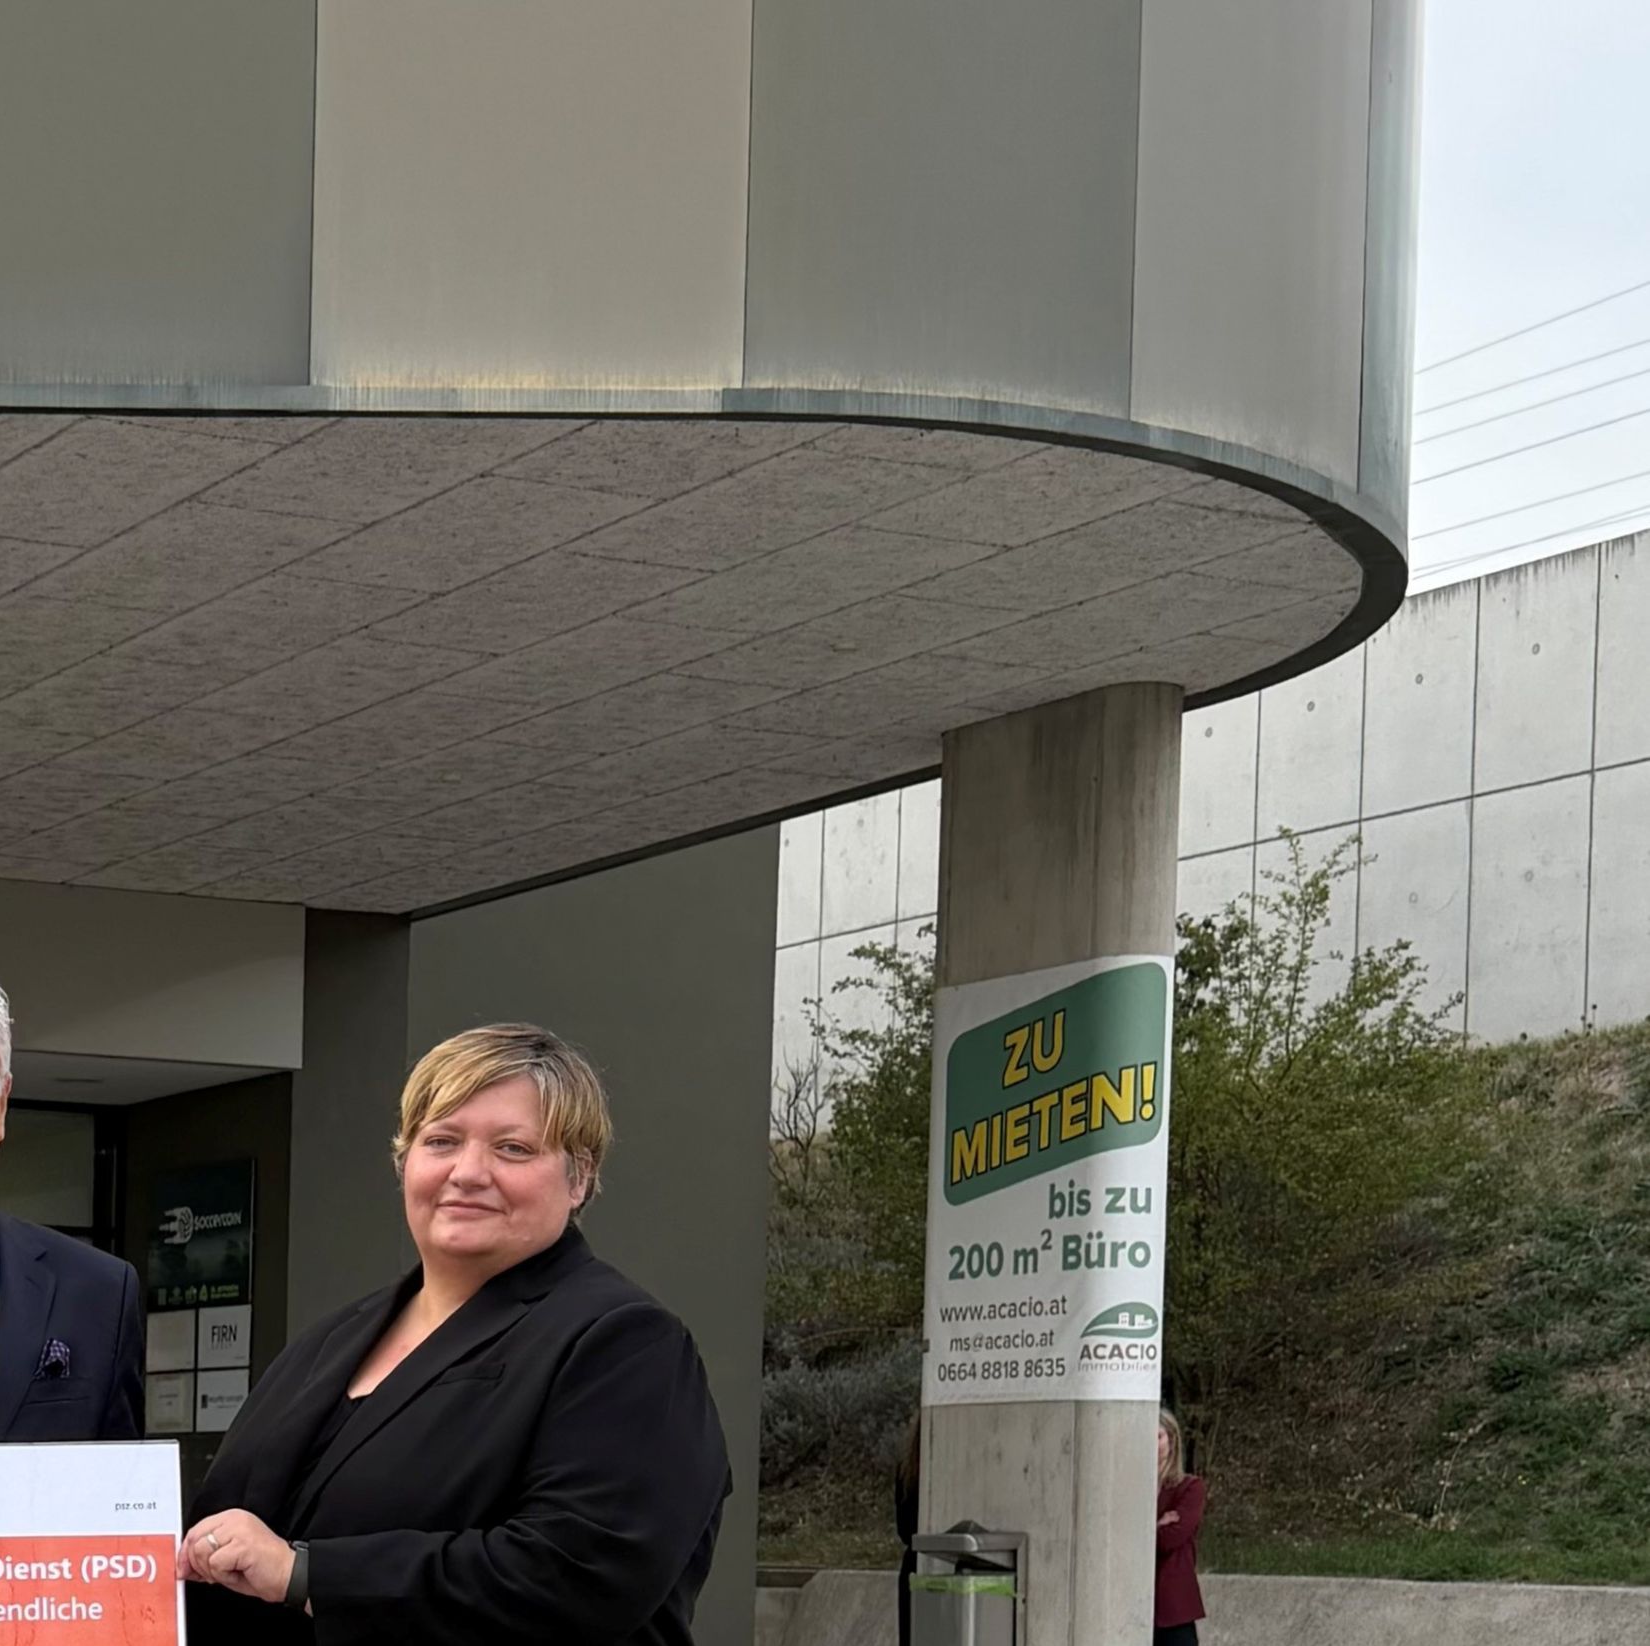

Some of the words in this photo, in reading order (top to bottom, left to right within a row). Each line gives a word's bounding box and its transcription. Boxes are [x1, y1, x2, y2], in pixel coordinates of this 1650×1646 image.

[1002, 1008, 1066, 1089] ZU
[951, 1061, 1157, 1186] MIETEN!
[1048, 1179, 1092, 1219] bis
[1104, 1187, 1152, 1214] zu
[948, 1241, 1005, 1281] 200
[1062, 1231, 1152, 1271] Büro
[939, 1296, 1067, 1322] www.acacio.at
[211, 1324, 238, 1345] FIRN
[949, 1329, 1054, 1352] ms@acacio.at
[1079, 1343, 1158, 1361] ACACIO
[937, 1362, 977, 1382] 0664
[981, 1360, 1020, 1380] 8818
[1023, 1358, 1066, 1379] 8635
[81, 1554, 157, 1583] (PSD)
